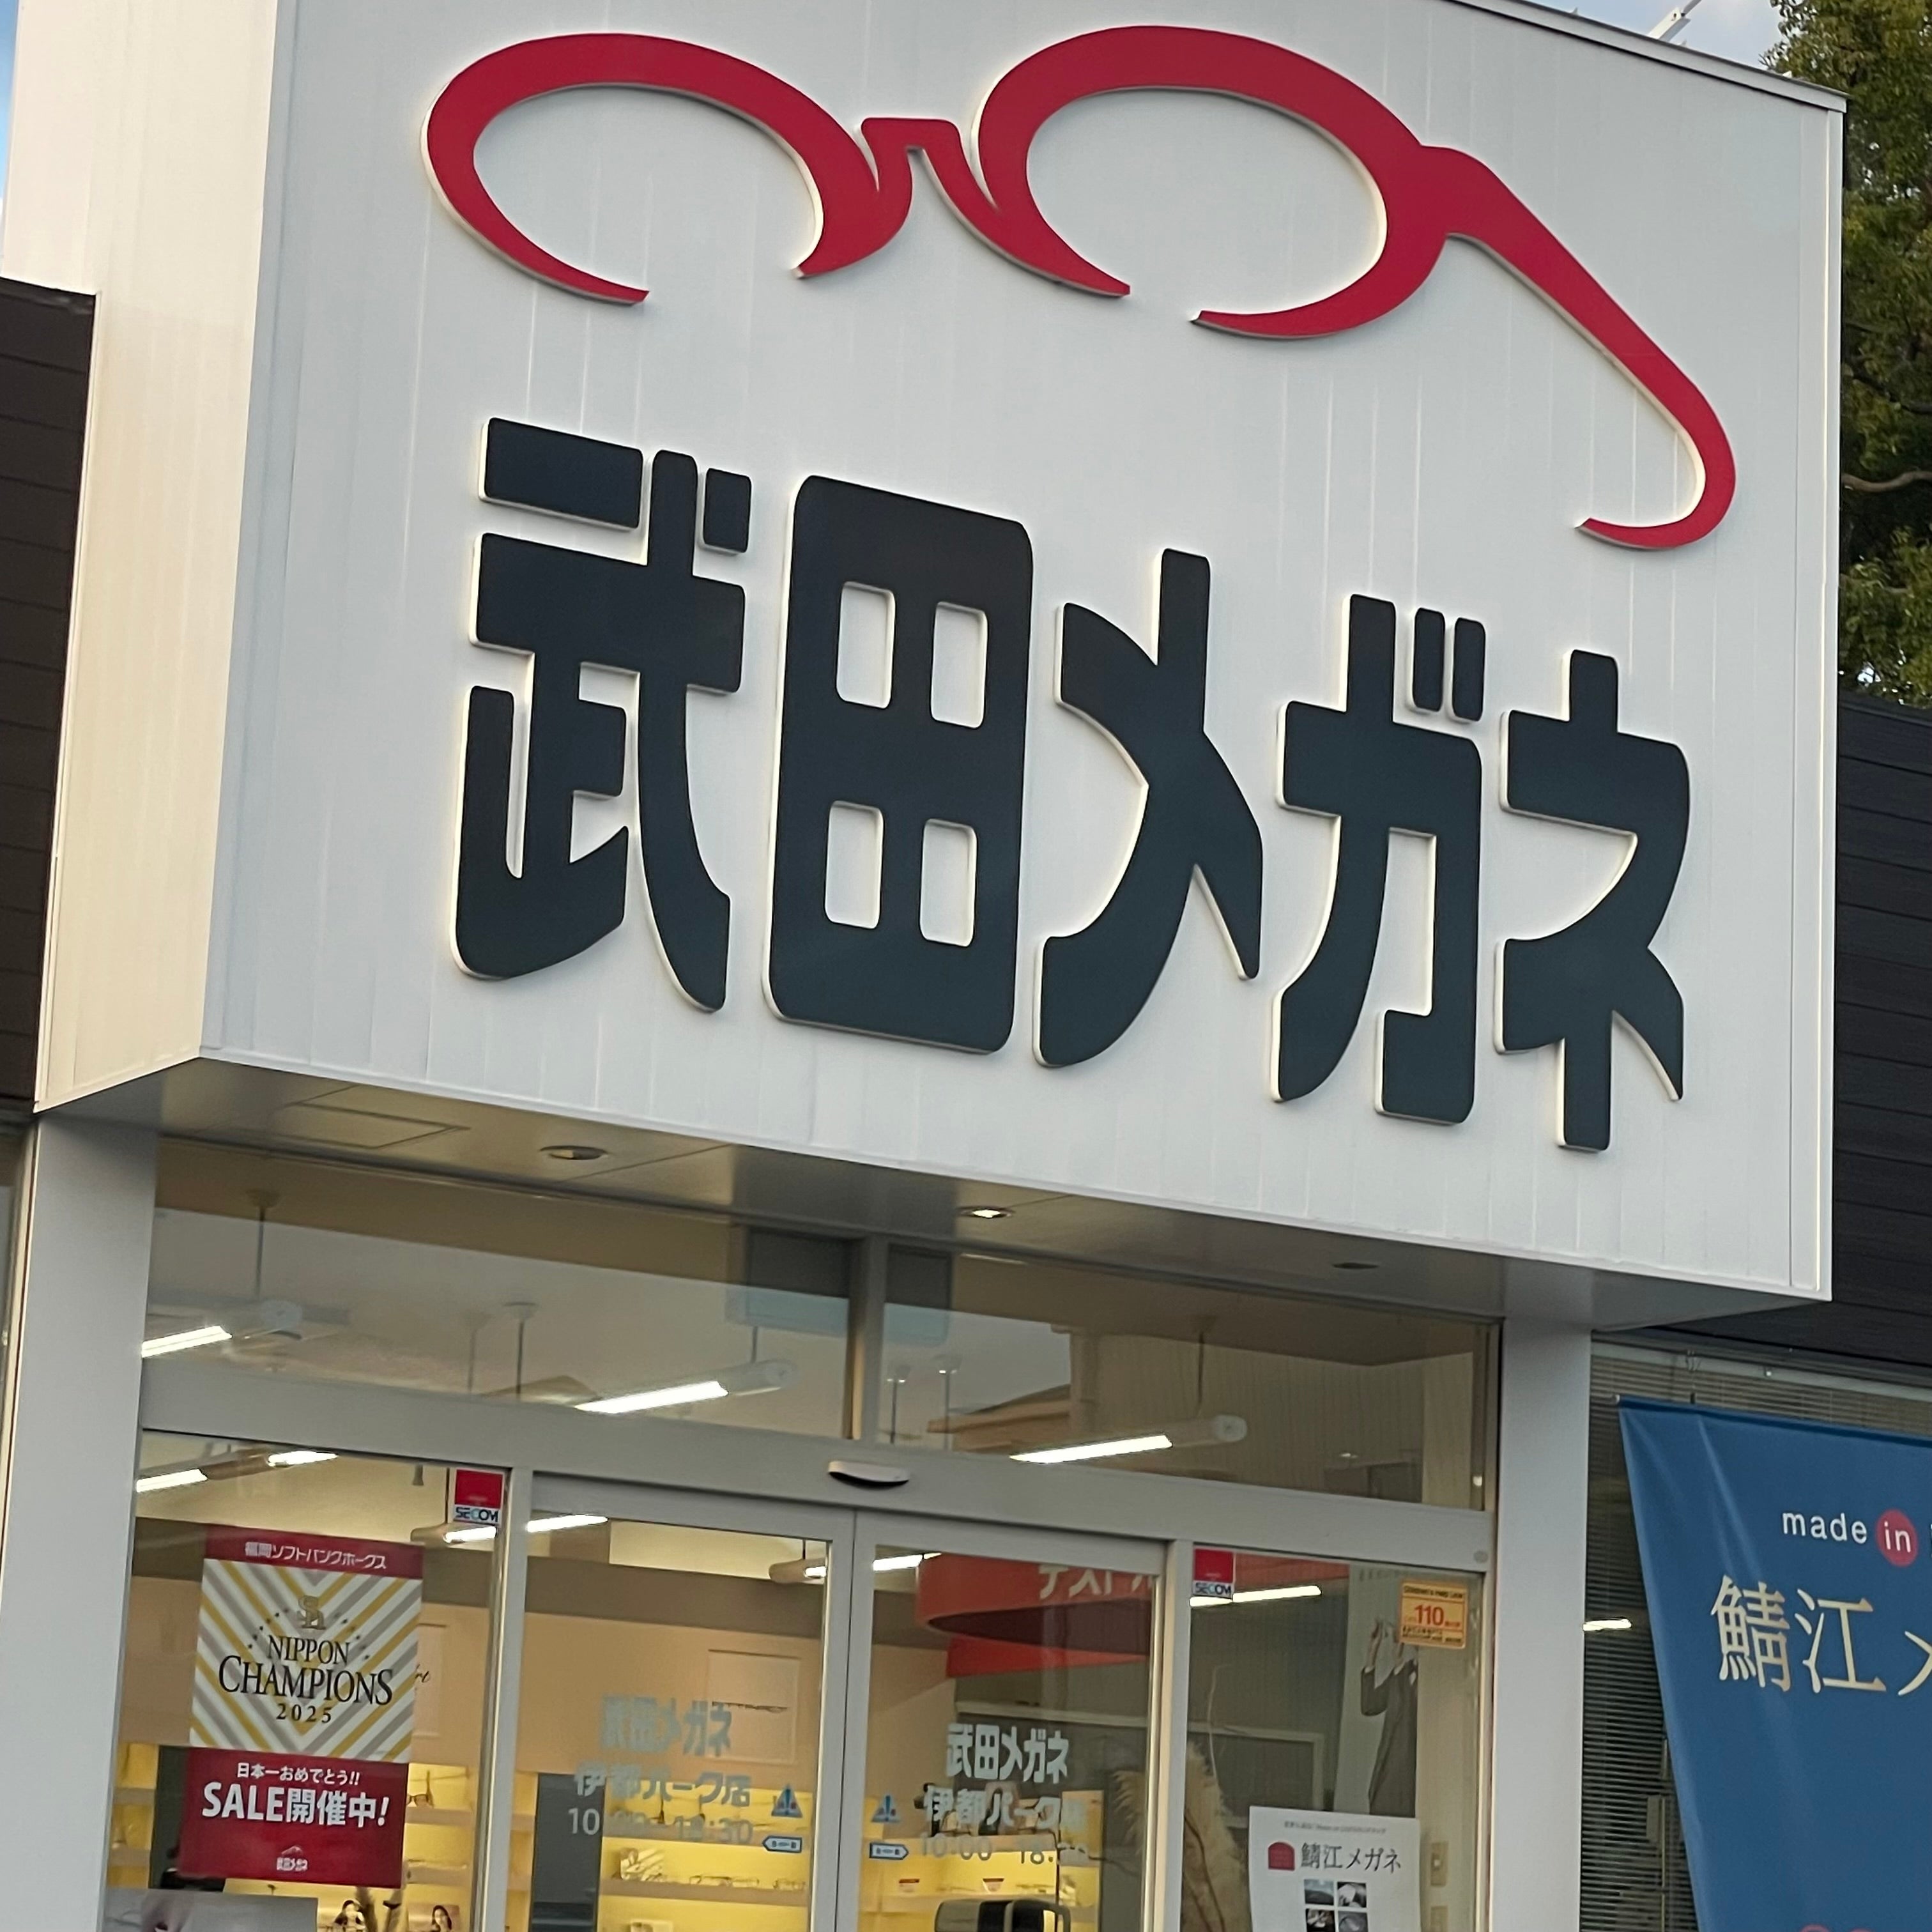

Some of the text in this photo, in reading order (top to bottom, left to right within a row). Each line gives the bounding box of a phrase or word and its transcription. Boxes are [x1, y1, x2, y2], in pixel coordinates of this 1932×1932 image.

[452, 417, 1690, 1151] 武田メガネ
[456, 1506, 498, 1522] SECOM
[1782, 1512, 1867, 1544] made
[1884, 1521, 1912, 1552] in
[1195, 1582, 1232, 1595] SECOM
[1414, 1604, 1444, 1626] 110
[267, 1634, 350, 1665] NIPPON
[218, 1655, 394, 1705] CHAMPIONS
[276, 1703, 332, 1723] 2025
[946, 1722, 1070, 1784] 武田メガネ
[202, 1781, 390, 1828] SALE開催中!
[1301, 1842, 1401, 1873] 鯖江メガネ
